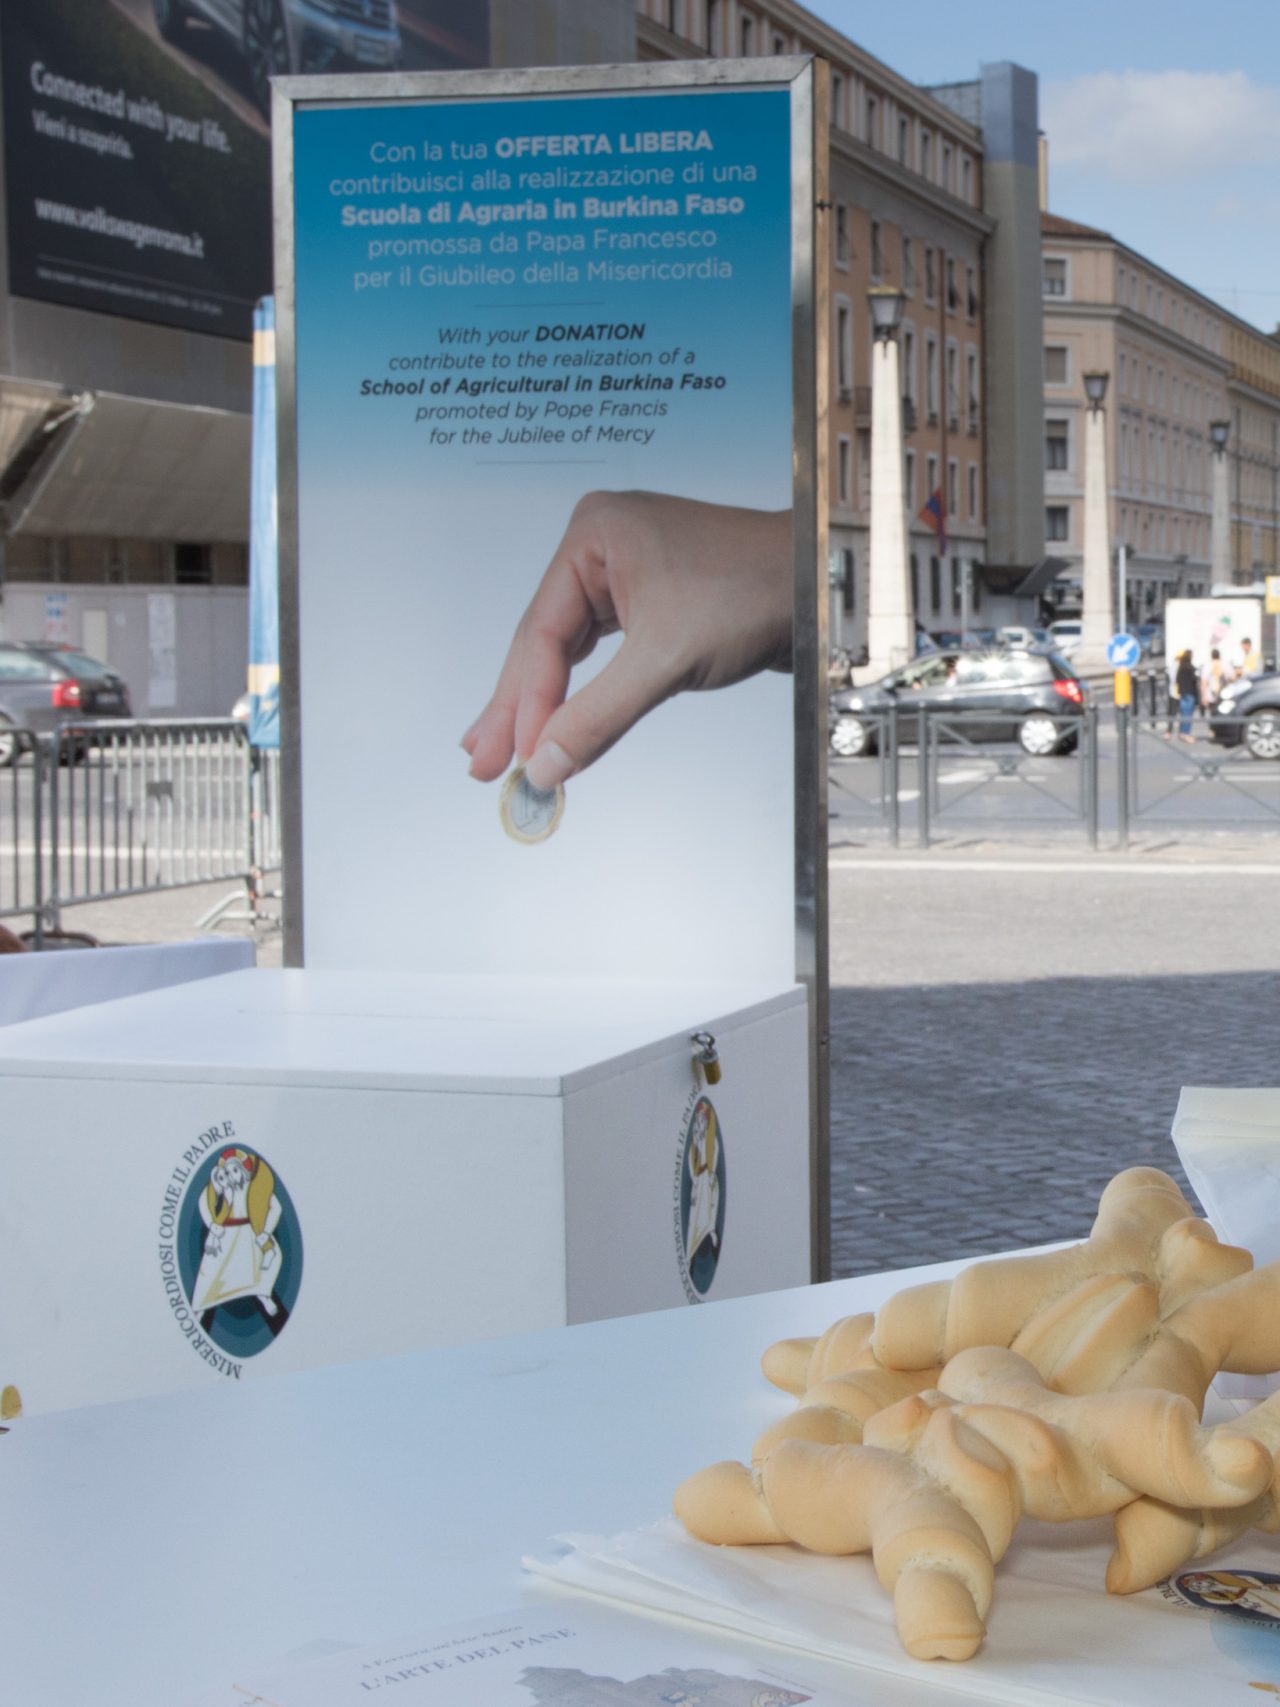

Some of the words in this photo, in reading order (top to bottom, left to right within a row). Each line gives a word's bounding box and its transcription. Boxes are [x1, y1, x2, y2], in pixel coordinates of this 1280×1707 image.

[30, 60, 125, 118] Connected
[126, 98, 165, 130] with
[165, 113, 201, 142] your
[370, 141, 415, 163] Con
[423, 140, 443, 161] la
[450, 143, 488, 160] tua
[495, 134, 612, 159] OFFERTA
[620, 130, 714, 154] LIBERA
[329, 171, 464, 196] contribuisci
[471, 169, 511, 192] alla
[518, 165, 675, 189] realizzazione
[682, 161, 705, 184] di
[712, 163, 757, 183] una
[341, 203, 421, 227] Scuola
[428, 201, 451, 224] di
[457, 199, 548, 227] Agraria
[554, 198, 577, 219] in
[583, 195, 679, 219] Burkina
[686, 194, 745, 216] Faso
[368, 234, 482, 260] promossa
[490, 232, 518, 254] da
[527, 231, 586, 256] Papa
[594, 227, 717, 251] Francesco
[354, 267, 392, 292] per
[399, 265, 412, 287] il
[419, 262, 515, 287] Giubileo
[523, 260, 579, 283] della
[587, 256, 733, 281] Misericordia
[438, 327, 481, 345] With
[487, 328, 530, 348] your
[535, 322, 646, 343] DONATION
[389, 352, 485, 371] contribute
[492, 353, 511, 369] to
[517, 350, 548, 369] the
[553, 348, 652, 367] realization
[659, 347, 682, 366] of
[684, 350, 696, 366] a
[360, 378, 424, 396] School
[430, 377, 451, 395] of
[455, 374, 570, 397] Agricultural
[575, 374, 593, 393] in
[599, 373, 674, 392] Burkina
[679, 372, 727, 391] Faso
[415, 402, 510, 423] promoted
[515, 401, 538, 422] by
[544, 401, 593, 421] Pope
[599, 398, 669, 418] Francis
[430, 426, 457, 446] for
[462, 426, 492, 445] the
[498, 424, 565, 444] Jubilee
[571, 424, 593, 443] of
[597, 425, 655, 446] Mercy
[183, 1120, 236, 1167] PADRE
[172, 1166, 191, 1188] IL
[159, 1183, 183, 1241] COME
[158, 1244, 243, 1381] MISERICORDIOSI
[360, 1658, 453, 1691] L'ARTE
[455, 1645, 510, 1665] DEL
[511, 1627, 577, 1650] PANE
